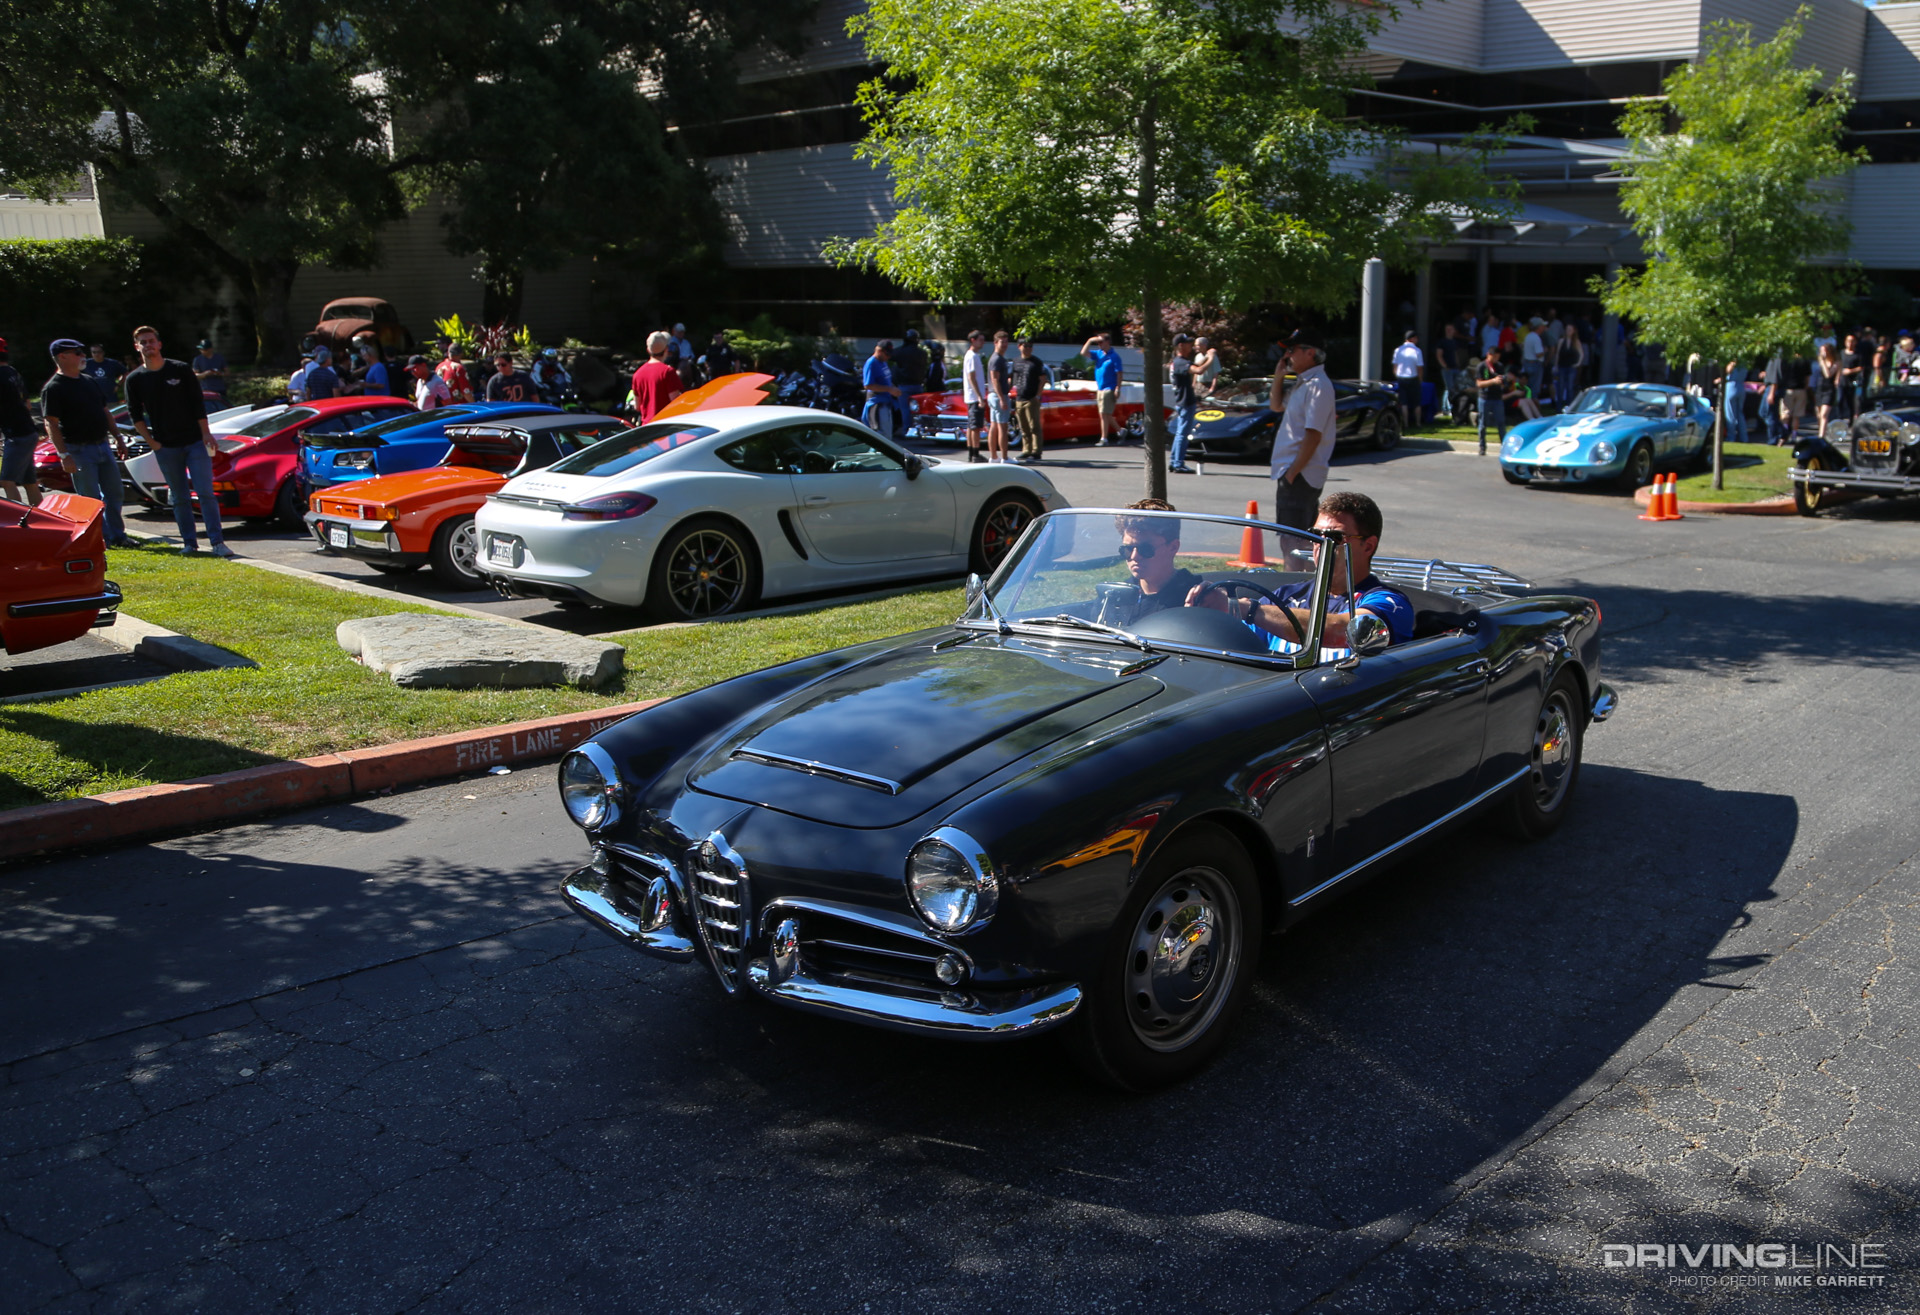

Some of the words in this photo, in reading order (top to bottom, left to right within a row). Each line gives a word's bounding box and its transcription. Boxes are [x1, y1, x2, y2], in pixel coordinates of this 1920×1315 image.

[501, 384, 524, 402] 30
[1544, 438, 1573, 454] 7
[456, 739, 502, 767] FIRE
[512, 728, 563, 755] LANE
